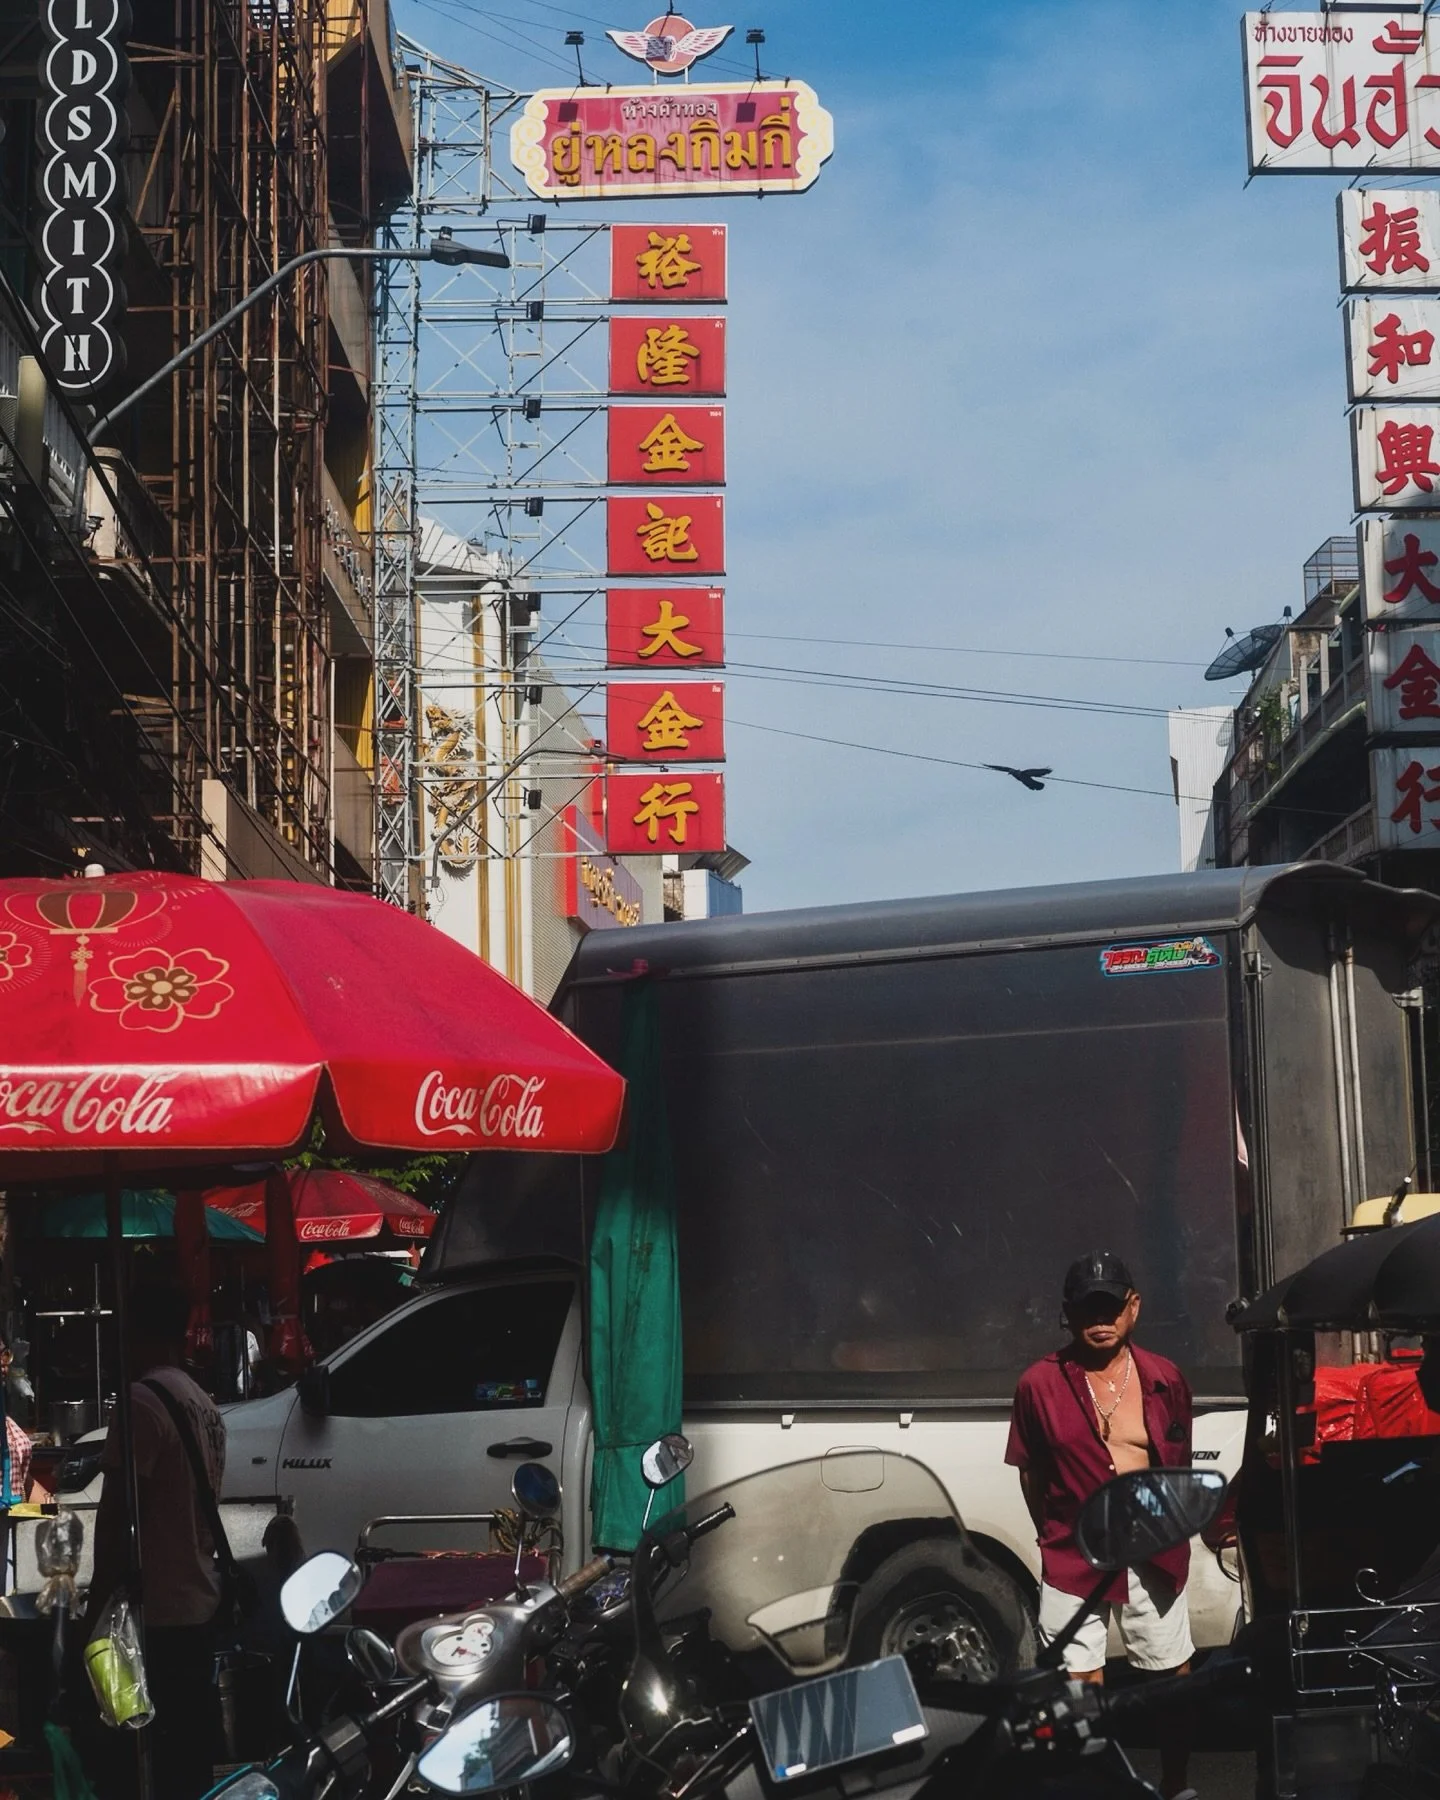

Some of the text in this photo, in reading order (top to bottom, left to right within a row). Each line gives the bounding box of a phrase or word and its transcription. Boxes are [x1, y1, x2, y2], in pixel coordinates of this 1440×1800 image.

[1255, 20, 1354, 44] ห้างขายทอง
[622, 98, 719, 120] ห้างค้าทอง
[552, 97, 792, 186] ยู่หลงกิมกี่
[415, 1070, 546, 1138] Coca-Cola
[301, 1219, 352, 1239] Coca-Cola
[282, 1457, 333, 1469] HILUX
